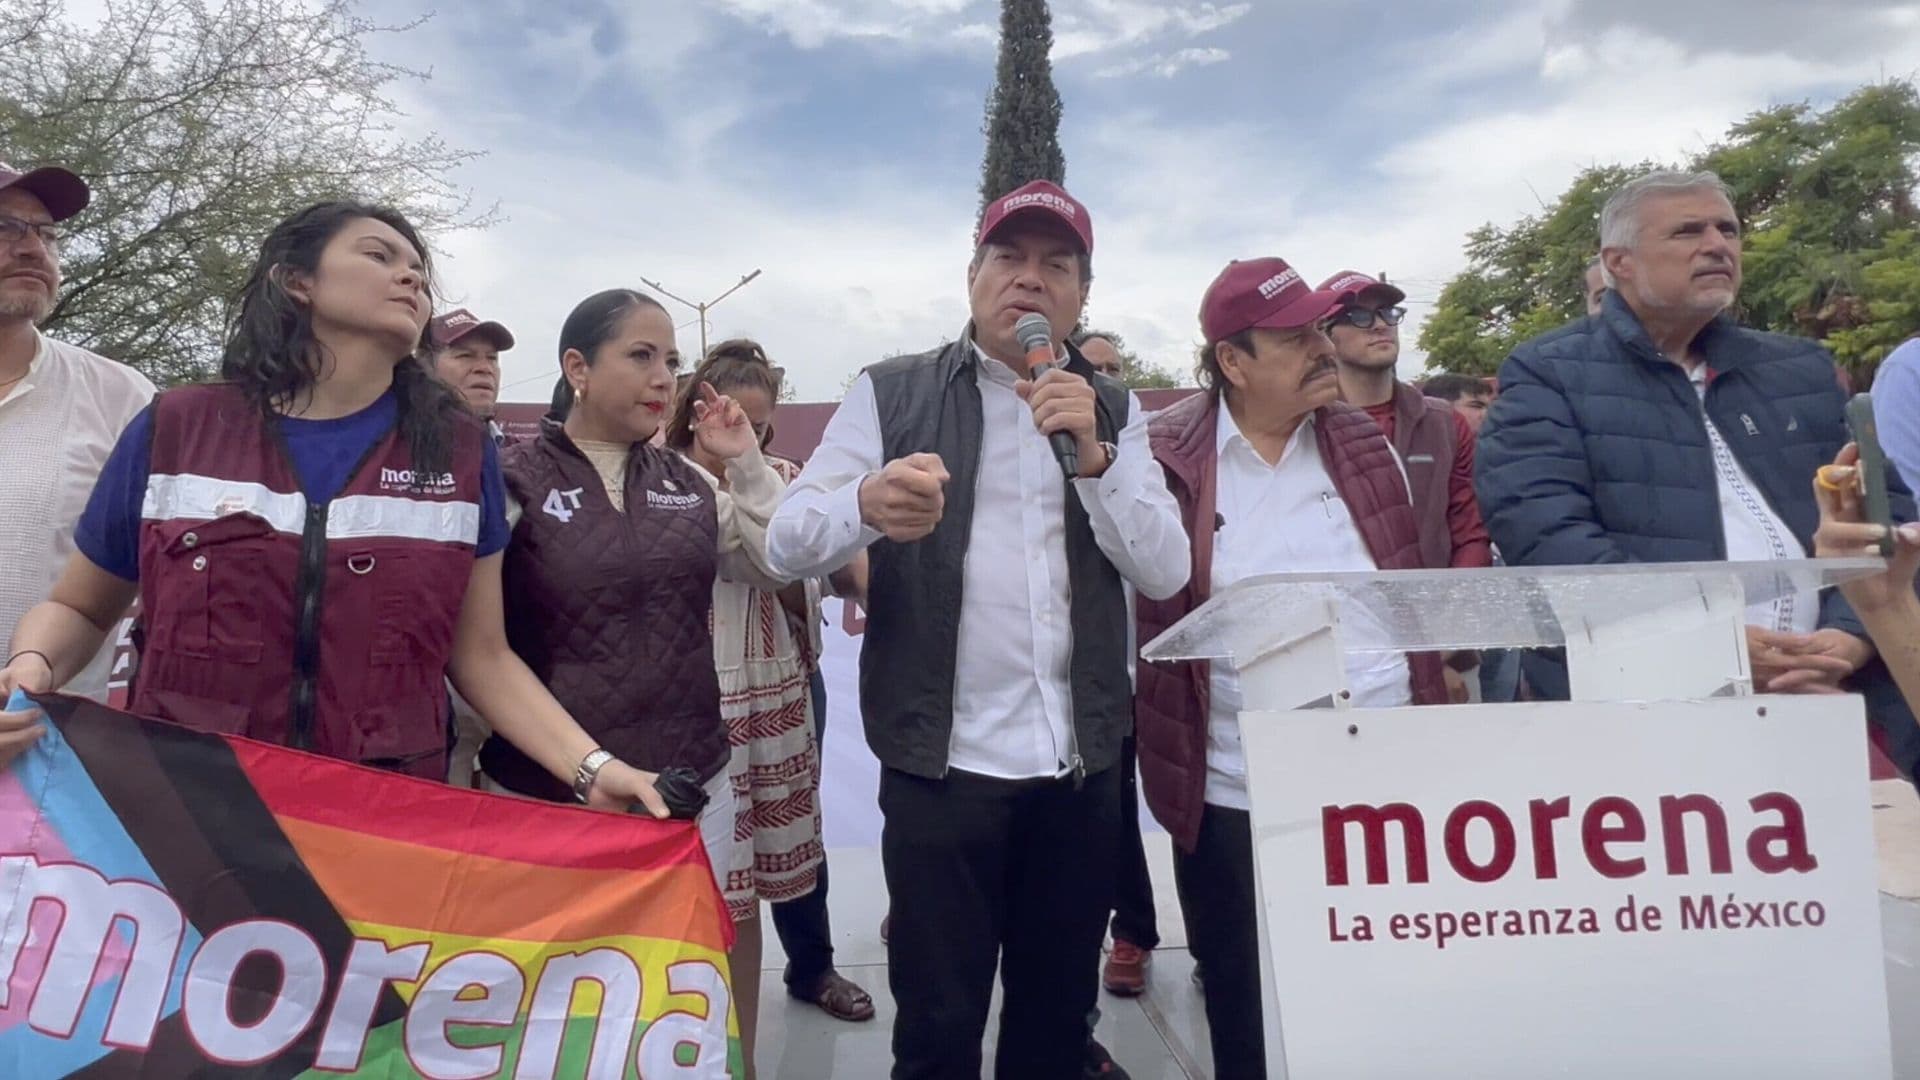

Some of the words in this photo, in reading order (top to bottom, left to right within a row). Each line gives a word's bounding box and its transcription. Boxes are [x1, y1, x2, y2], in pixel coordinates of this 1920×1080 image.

[1003, 192, 1074, 215] morena
[1258, 267, 1299, 295] more
[542, 487, 584, 523] 4T
[647, 489, 700, 505] morena
[1322, 791, 1818, 886] morena
[1328, 907, 1374, 942] La
[1390, 907, 1600, 949] esperanza
[1615, 894, 1662, 932] de
[1680, 893, 1826, 931] México
[0, 853, 733, 1080] morena
